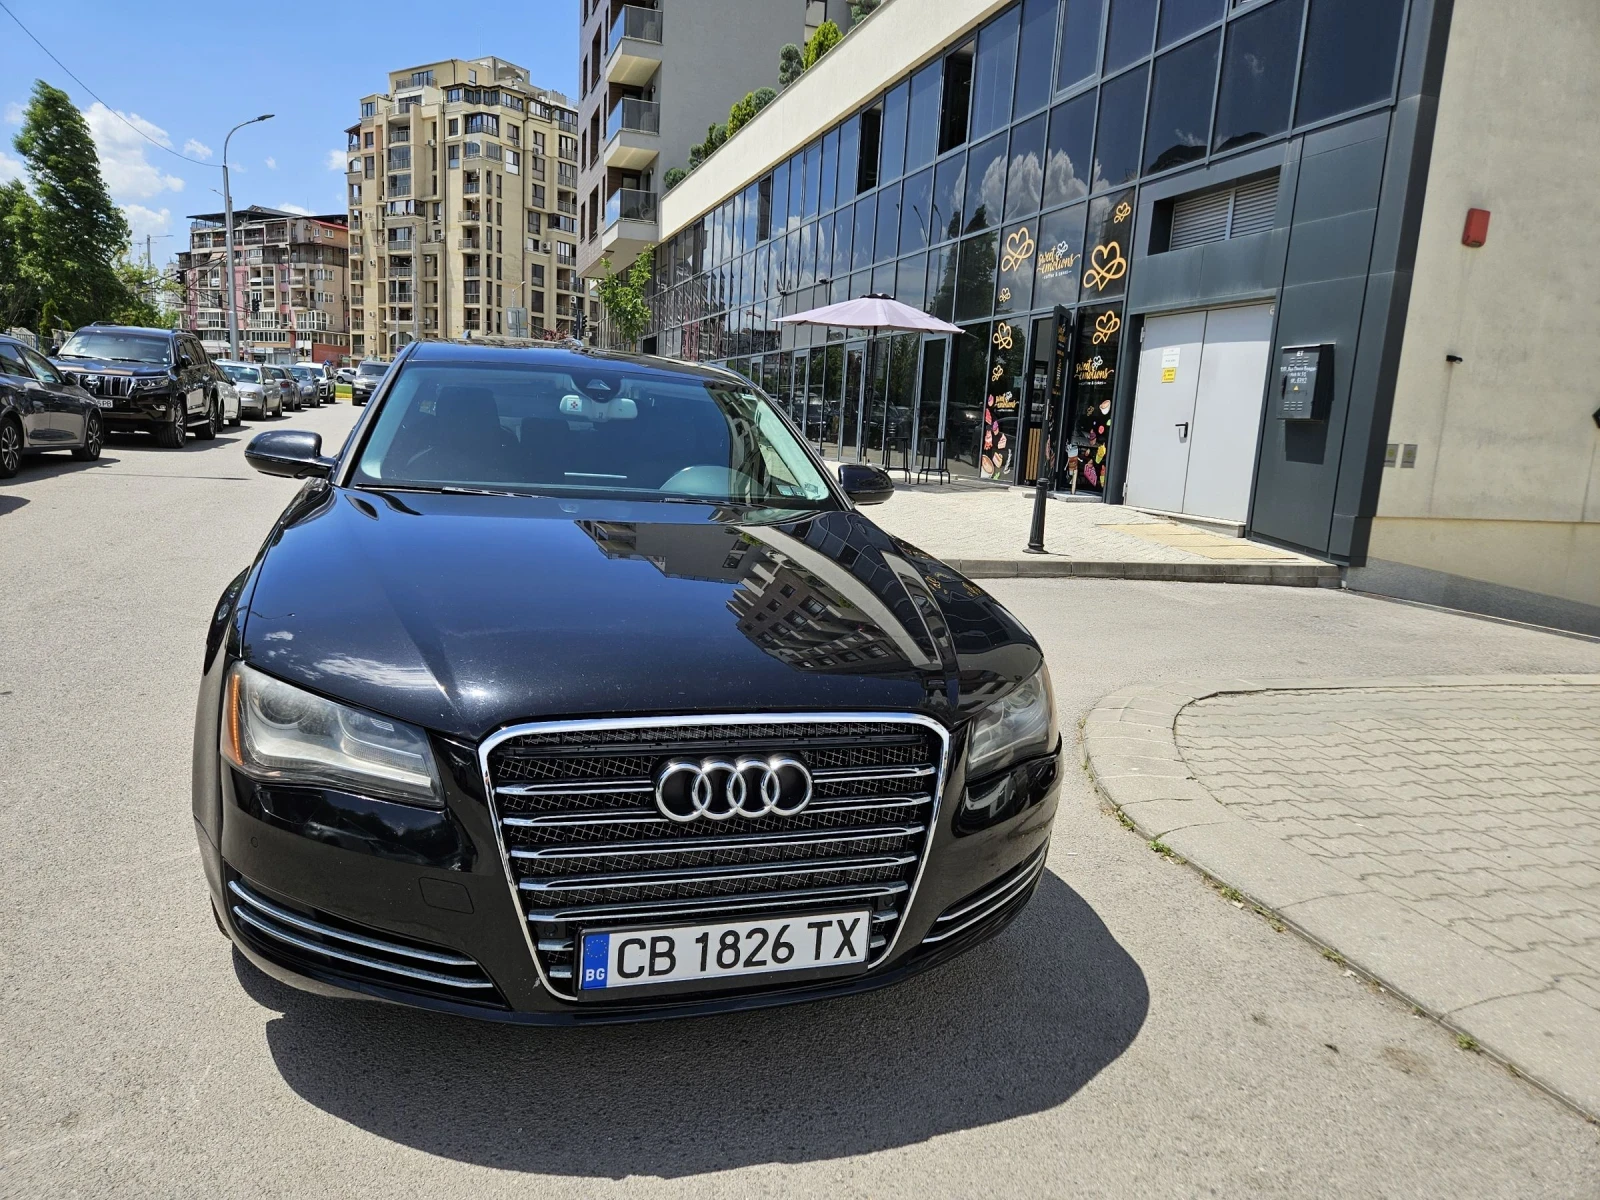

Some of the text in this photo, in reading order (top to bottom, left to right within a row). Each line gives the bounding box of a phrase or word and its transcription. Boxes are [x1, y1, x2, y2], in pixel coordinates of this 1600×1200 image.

[1037, 253, 1081, 274] emotions
[1074, 367, 1115, 381] emotions
[617, 917, 861, 979] CB 1826 TX
[585, 967, 605, 982] BG
